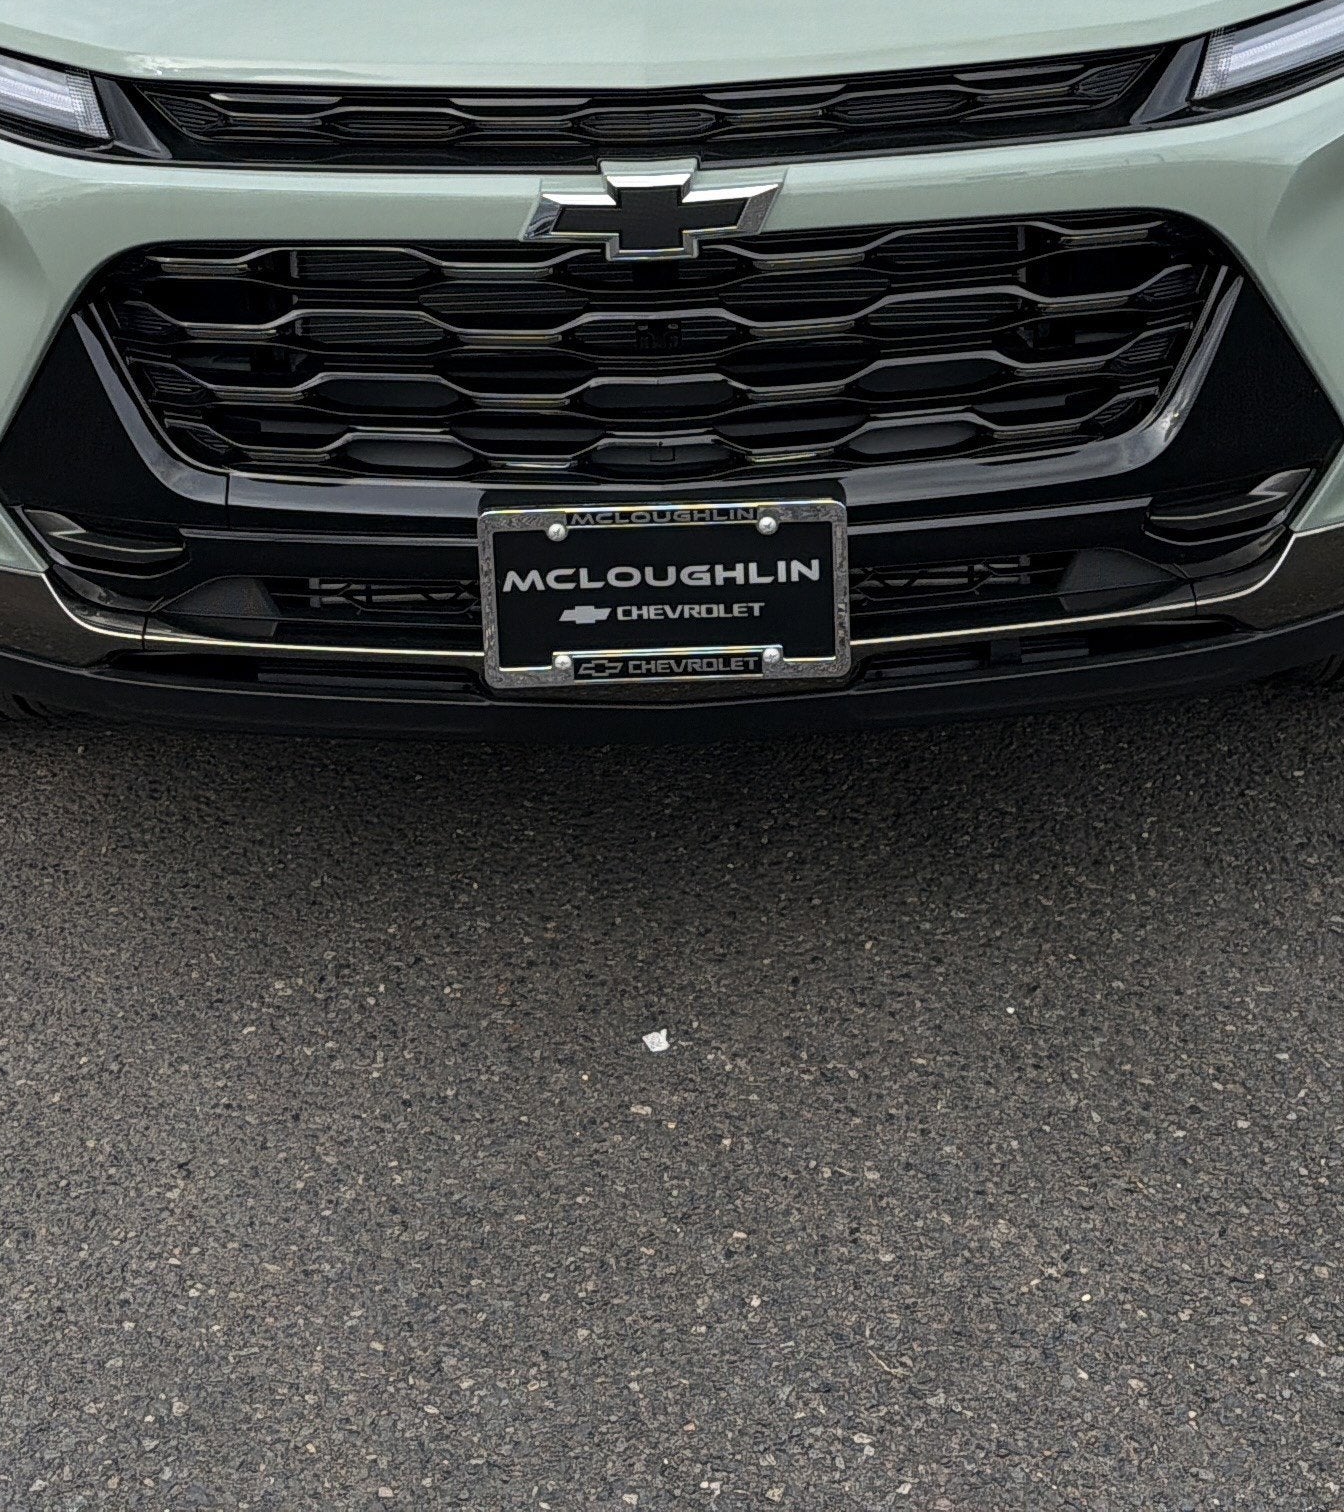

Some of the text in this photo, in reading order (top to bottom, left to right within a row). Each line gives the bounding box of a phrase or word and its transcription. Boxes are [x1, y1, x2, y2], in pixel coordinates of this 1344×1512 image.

[570, 507, 755, 526] MCLOUGHLIN
[502, 559, 821, 593] MCLOUGHLIN
[616, 602, 765, 621] CHEVROLET
[627, 656, 759, 675] CHEVROLET
